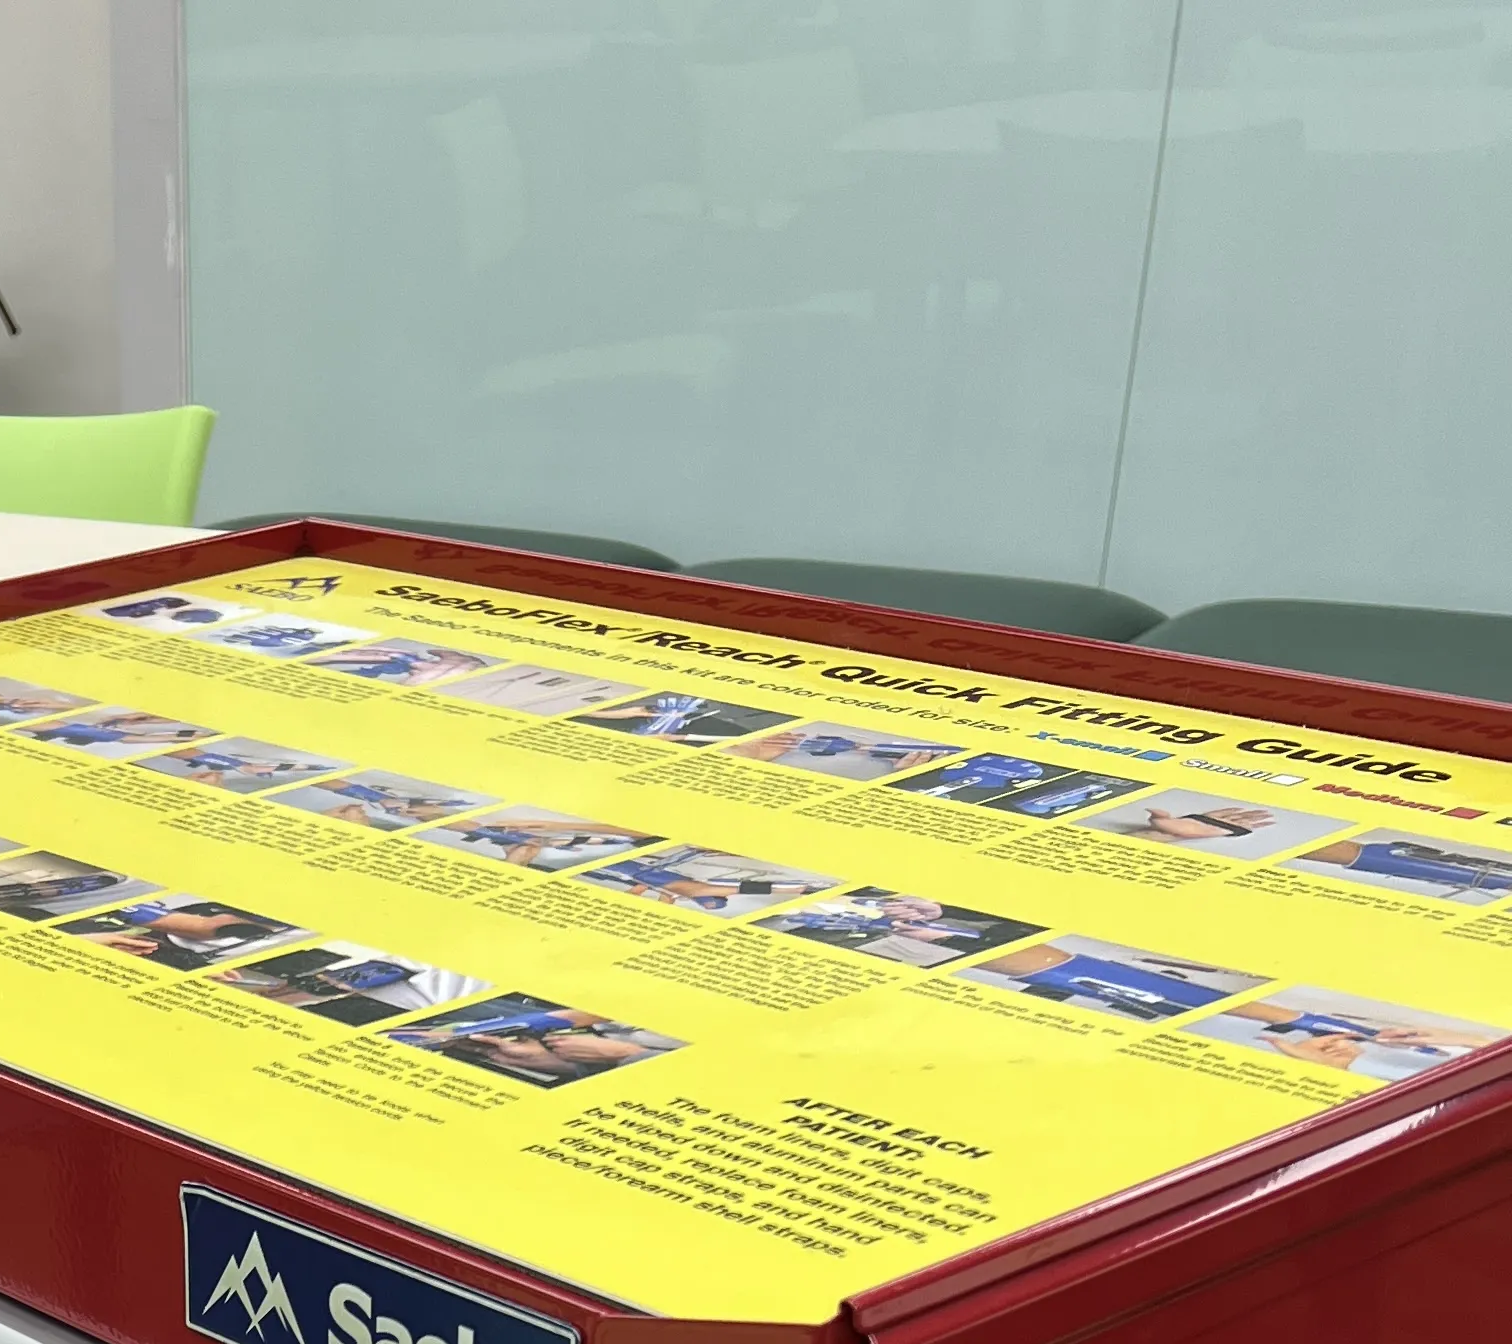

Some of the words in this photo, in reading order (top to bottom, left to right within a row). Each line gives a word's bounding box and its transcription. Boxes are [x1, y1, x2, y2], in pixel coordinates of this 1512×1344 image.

[363, 605, 402, 618] The
[471, 628, 607, 657] components
[604, 652, 633, 663] in
[631, 658, 679, 671] this
[678, 666, 717, 678] kit
[712, 674, 756, 685] are
[756, 682, 826, 698] color
[824, 695, 913, 714] coded
[907, 708, 953, 721] for
[950, 717, 1020, 734] size:
[1178, 758, 1273, 780] Small
[1311, 782, 1445, 813] Medium
[819, 665, 1000, 703] Quick
[998, 695, 1226, 745] Fitting
[1235, 737, 1452, 783] Guide
[562, 1117, 591, 1128] If
[582, 1126, 680, 1161] needed,
[679, 1157, 776, 1191] replace
[777, 1187, 848, 1214] foam
[847, 1209, 927, 1244] liners,
[581, 1106, 616, 1120] be
[617, 1118, 696, 1145] wiped
[691, 1143, 762, 1168] down
[761, 1165, 820, 1184] and
[816, 1182, 970, 1235] disinfected.
[613, 1100, 685, 1128] shells,
[689, 1125, 747, 1142] and
[740, 1140, 867, 1181] aluminum
[863, 1178, 942, 1204] parts
[942, 1203, 997, 1223] can
[666, 1097, 711, 1115] The
[711, 1112, 777, 1136] foam
[776, 1131, 851, 1161] liners,
[858, 1158, 923, 1179] digit
[921, 1177, 990, 1204] caps,
[781, 1114, 924, 1161] PATIENT:
[782, 1097, 893, 1130] AFTER
[891, 1127, 992, 1159] EACH
[519, 1143, 693, 1203] piece/forearm
[692, 1200, 763, 1225] shell
[757, 1222, 845, 1258] straps.
[558, 1136, 617, 1157] digit
[613, 1155, 662, 1173] cap
[661, 1171, 744, 1204] straps,
[750, 1200, 811, 1220] and
[805, 1216, 882, 1245] hand
